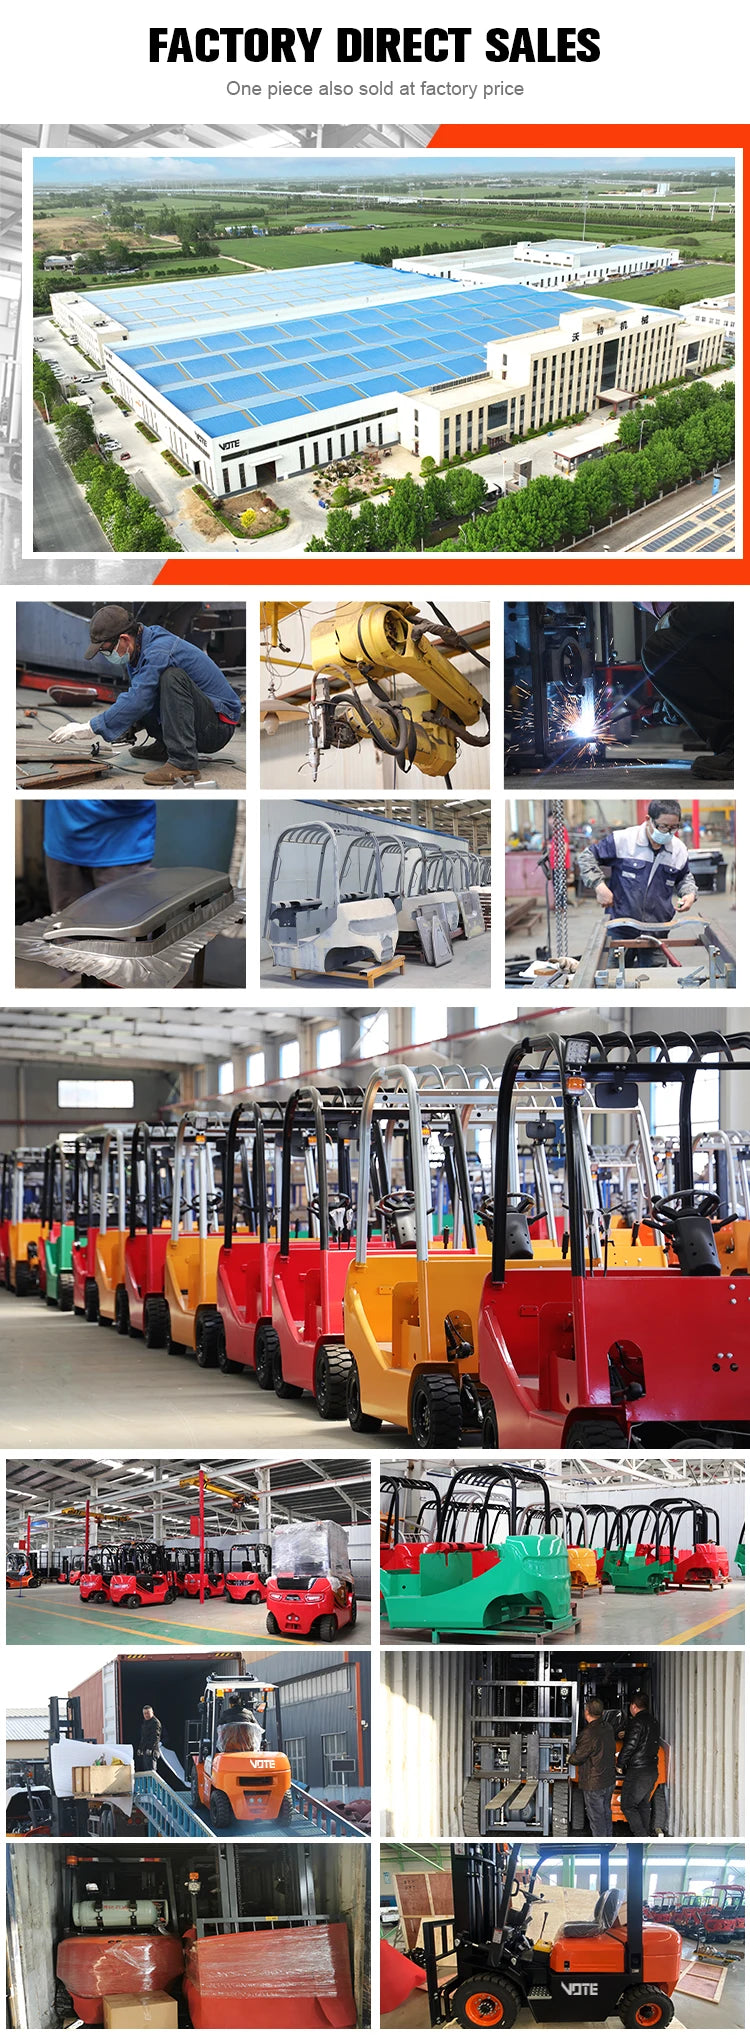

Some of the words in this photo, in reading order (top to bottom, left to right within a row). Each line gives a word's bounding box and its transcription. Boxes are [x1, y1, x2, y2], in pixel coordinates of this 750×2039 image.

[218, 439, 240, 451] VOTE
[249, 1758, 276, 1769] VOTE
[560, 1981, 598, 1996] VOTE
